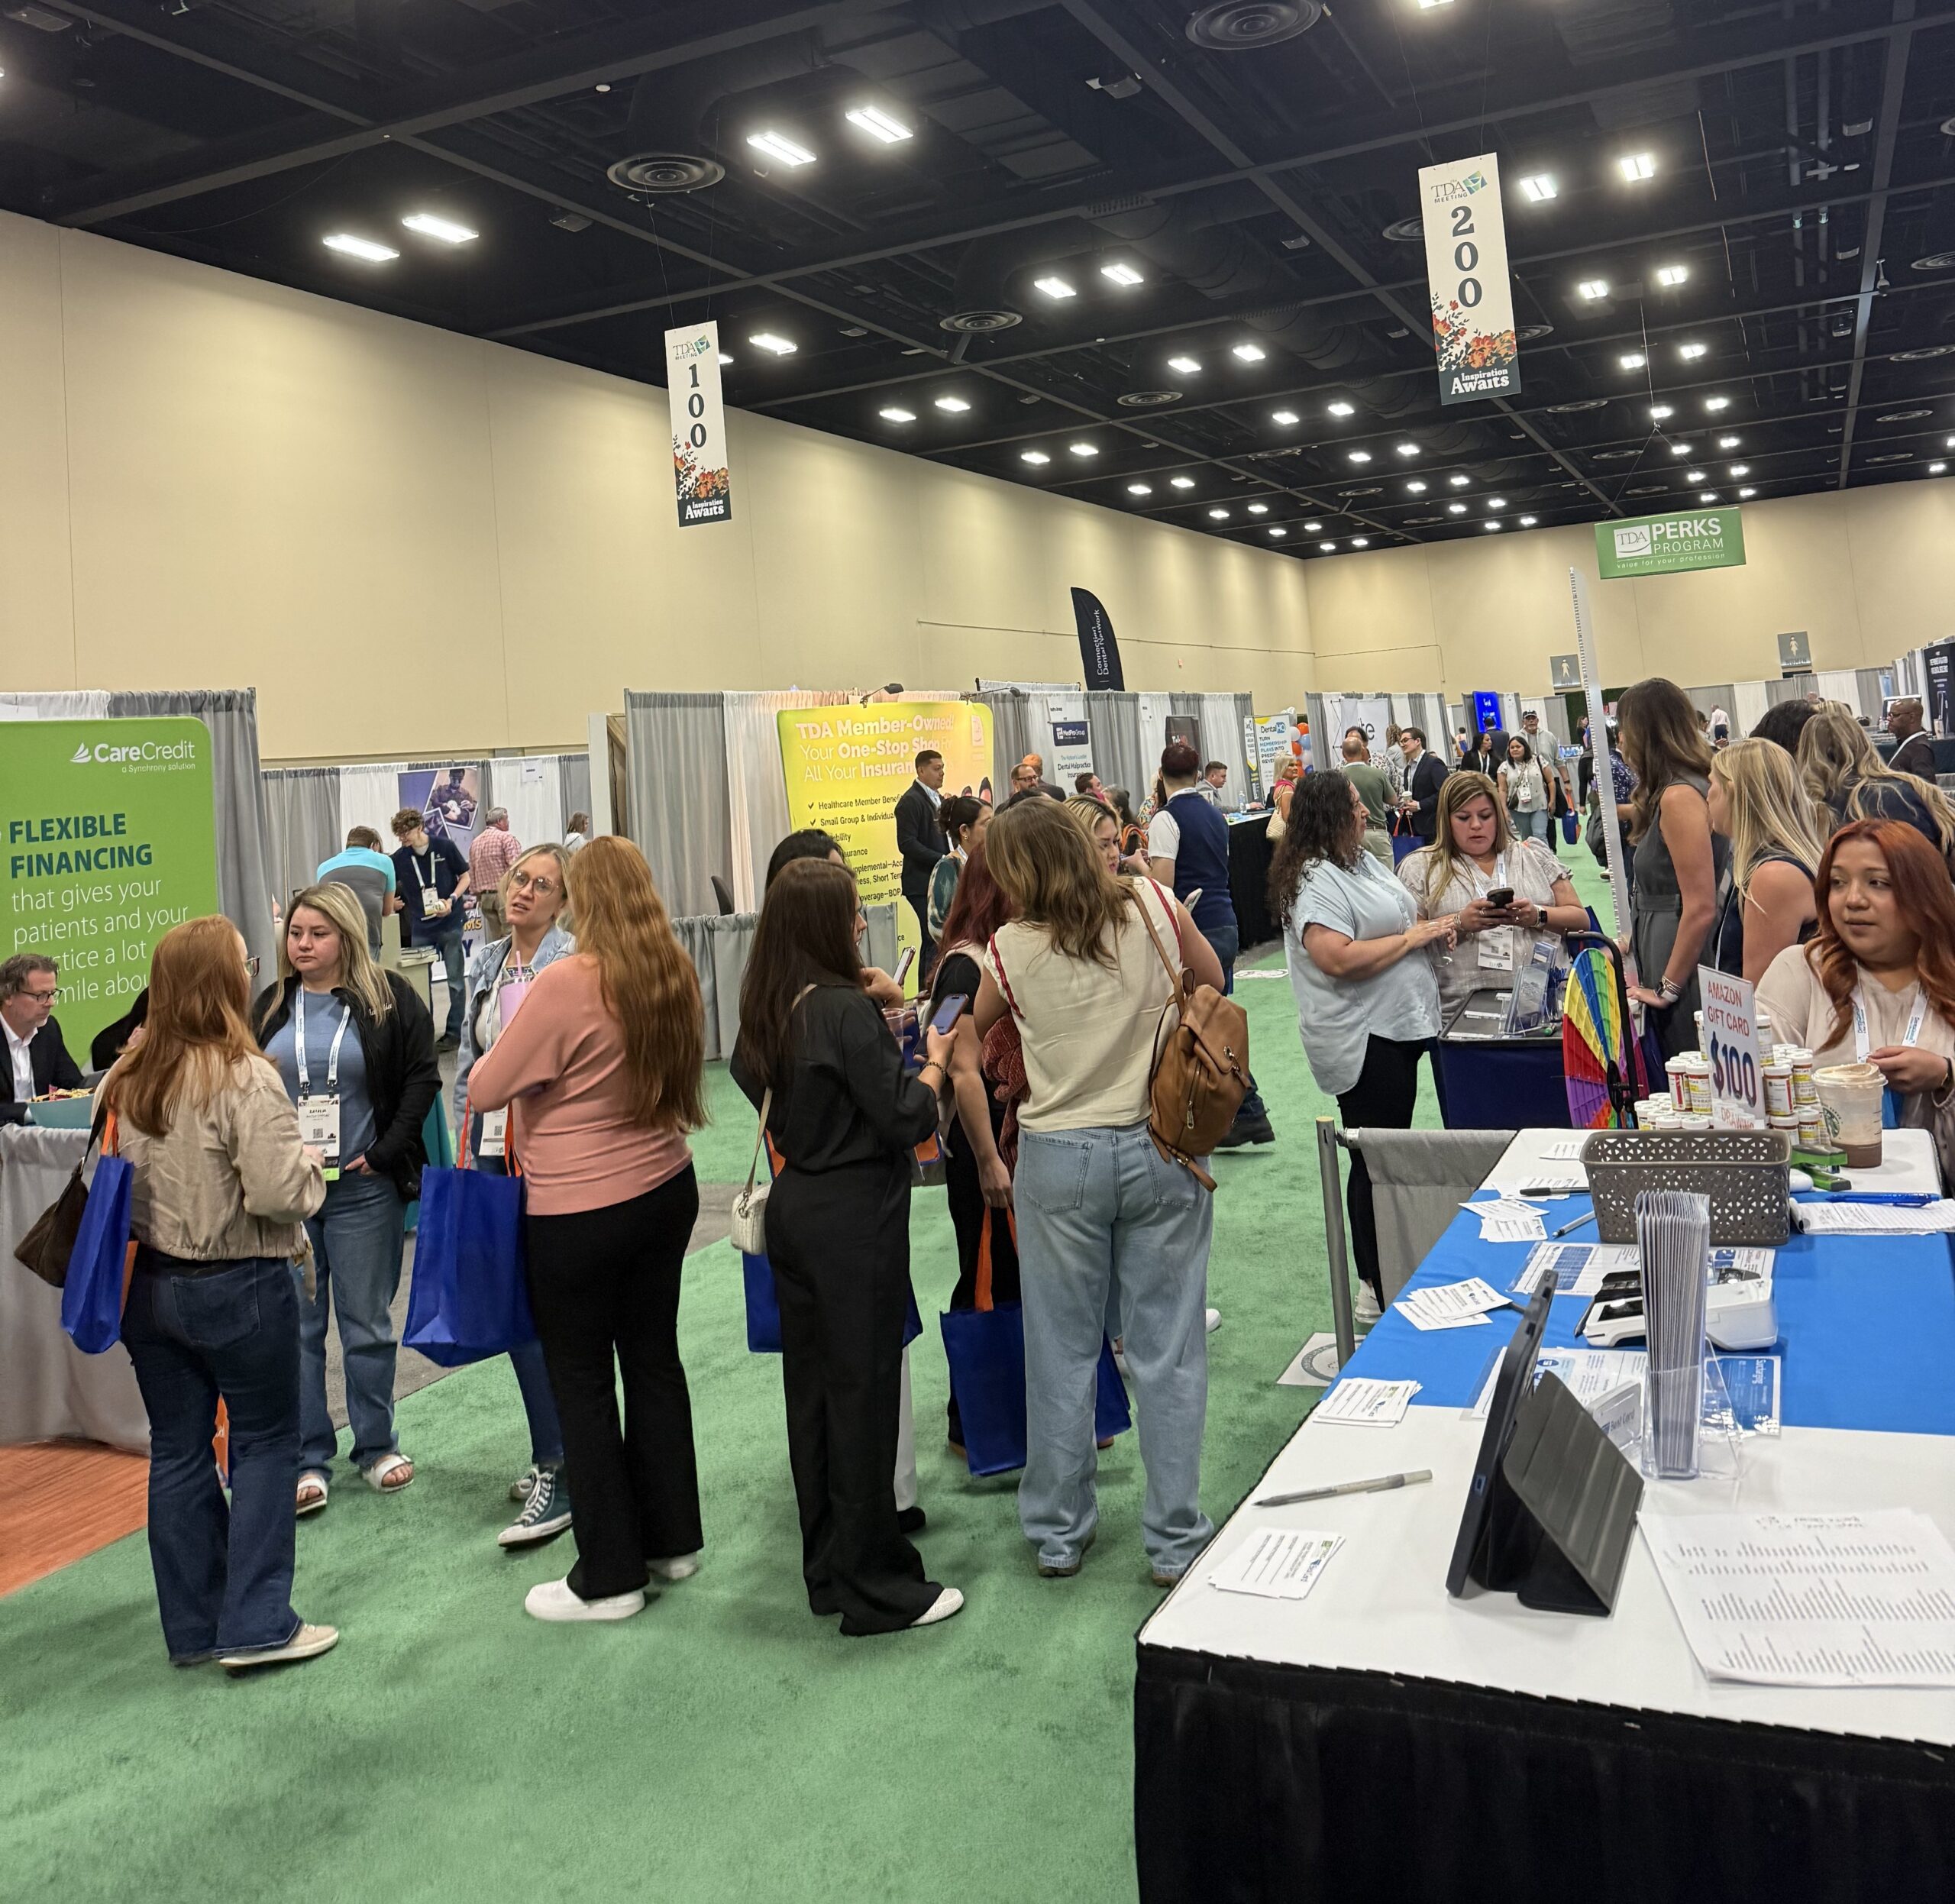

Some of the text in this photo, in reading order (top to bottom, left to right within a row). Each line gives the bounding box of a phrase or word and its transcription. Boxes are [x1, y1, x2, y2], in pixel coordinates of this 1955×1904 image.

[1430, 181, 1466, 198] TDA
[1434, 191, 1468, 203] MEETING
[1451, 205, 1482, 308] 200
[673, 341, 696, 356] TDA
[675, 352, 698, 360] MEETING
[1451, 373, 1510, 395] Awaits
[1461, 367, 1508, 382] Inspiration
[688, 363, 707, 448] 100
[685, 504, 725, 520] Awaits
[692, 498, 724, 509] Inspiration
[1617, 517, 1722, 545] TDA PERKS
[1653, 537, 1724, 554] PROGRAM
[1657, 558, 1675, 566] your
[1680, 552, 1725, 563] profession
[1091, 626, 1103, 676] Connection
[1094, 609, 1110, 675] Dental Network
[797, 721, 834, 739] TDA
[94, 739, 196, 763] CareCredit
[800, 744, 835, 761] Your
[838, 739, 910, 759] One-Stop
[128, 765, 166, 774] Synchrony
[168, 762, 196, 771] solution
[804, 761, 916, 782] All Your Insuran
[819, 794, 903, 810] Healthcare Member Benefi
[9, 813, 127, 844] FLEXIBLE
[820, 811, 895, 826] Small Group & Individua
[11, 843, 153, 878] FINANCING
[873, 874, 889, 884] Short
[11, 879, 161, 912] that gives your
[15, 906, 189, 952] patients and your
[105, 948, 115, 965] a
[122, 939, 147, 962] lot
[57, 977, 99, 1005] mile
[1708, 980, 1742, 1008] AMAZON
[1708, 1005, 1750, 1037] GIFT CARD
[1710, 1031, 1756, 1108] $100
